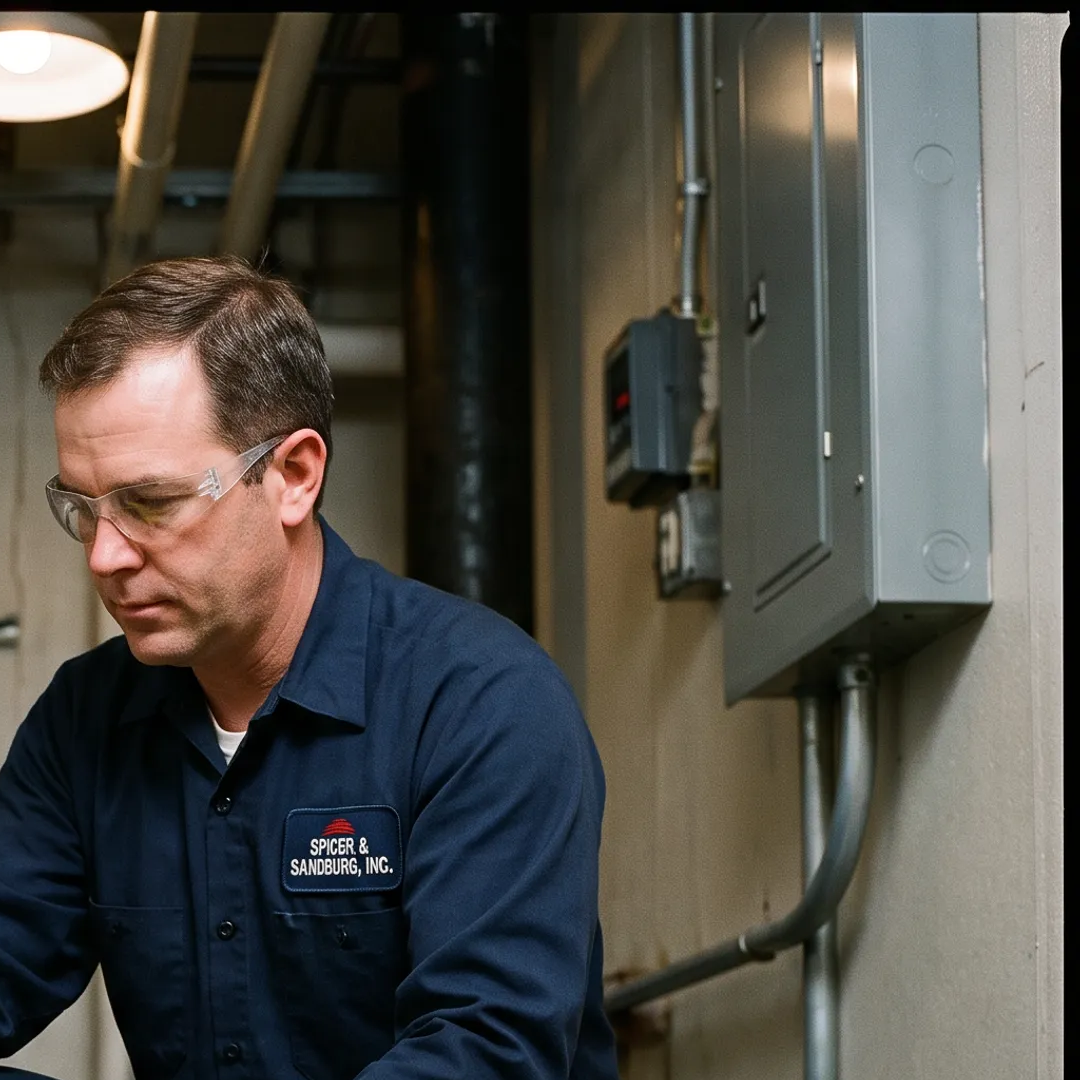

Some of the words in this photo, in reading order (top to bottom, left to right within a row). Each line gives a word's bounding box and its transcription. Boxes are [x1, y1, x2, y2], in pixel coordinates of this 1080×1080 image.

[358, 837, 369, 855] &
[290, 858, 361, 877] SANDBURG,
[366, 856, 393, 875] INC.
